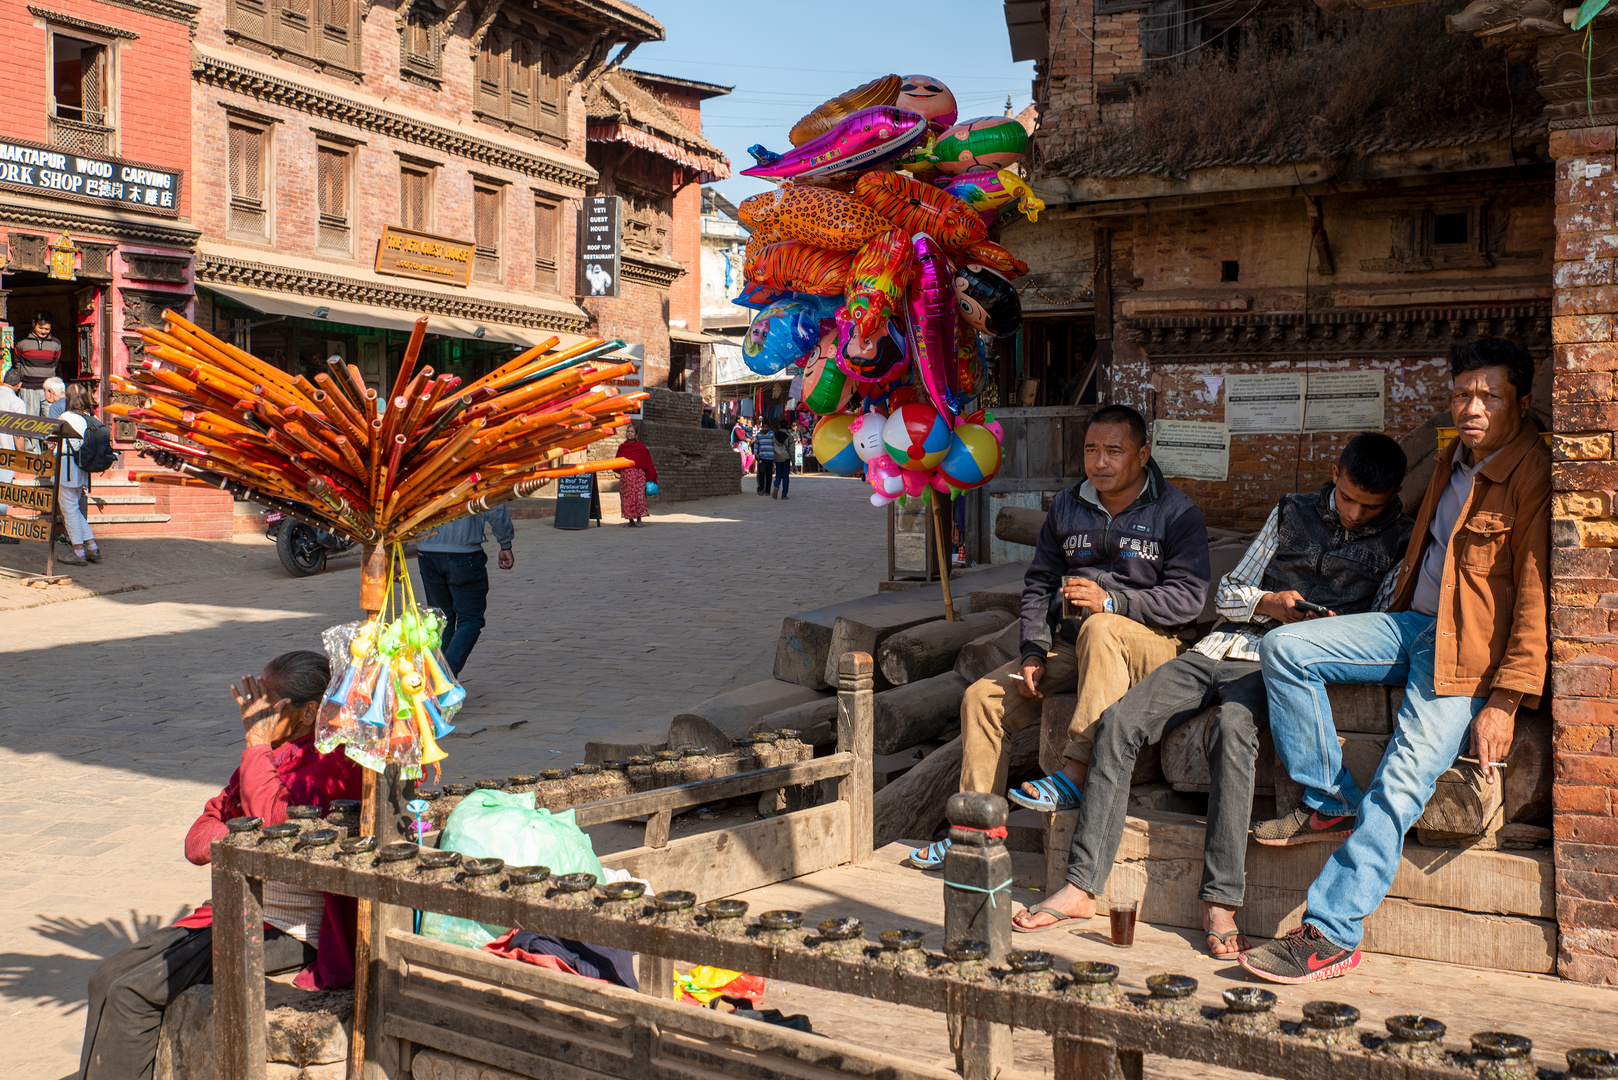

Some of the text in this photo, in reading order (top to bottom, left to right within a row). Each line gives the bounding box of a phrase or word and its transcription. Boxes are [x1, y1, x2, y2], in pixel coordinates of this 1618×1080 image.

[39, 169, 83, 193] SHOP
[75, 157, 113, 179] WOOD
[121, 166, 172, 190] CARVING
[387, 234, 470, 263] THE YETI GUEST HOUSE
[9, 417, 58, 435] HOME
[25, 456, 53, 473] TOP
[11, 520, 48, 540] HOUSE
[1119, 549, 1138, 559] Sport
